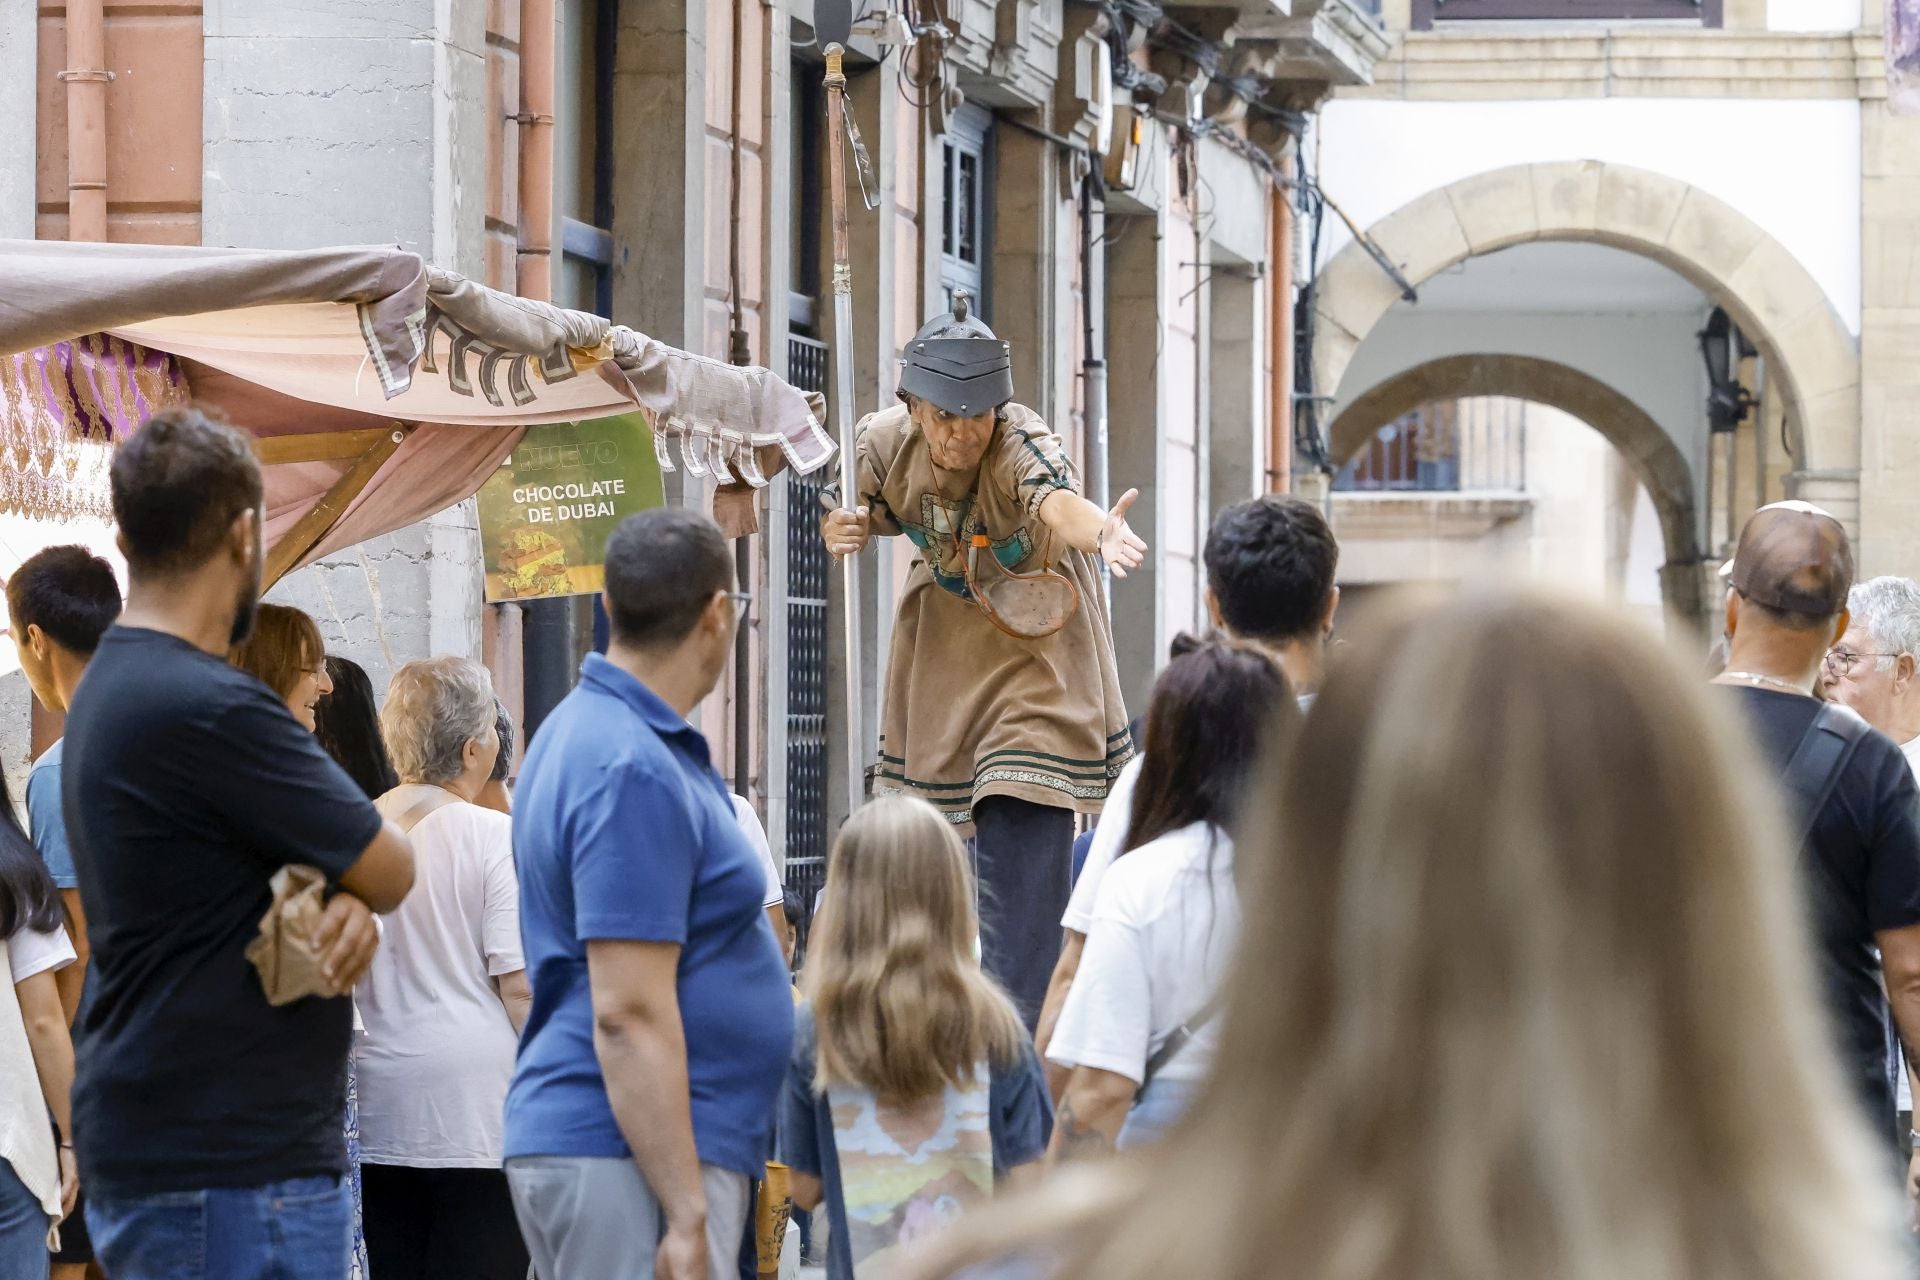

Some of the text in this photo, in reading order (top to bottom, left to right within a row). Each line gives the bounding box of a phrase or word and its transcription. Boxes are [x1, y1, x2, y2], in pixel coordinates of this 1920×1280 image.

[519, 440, 619, 472] NUEVO
[513, 479, 625, 504] CHOCOLATE
[528, 501, 615, 523] DE DUBAI
